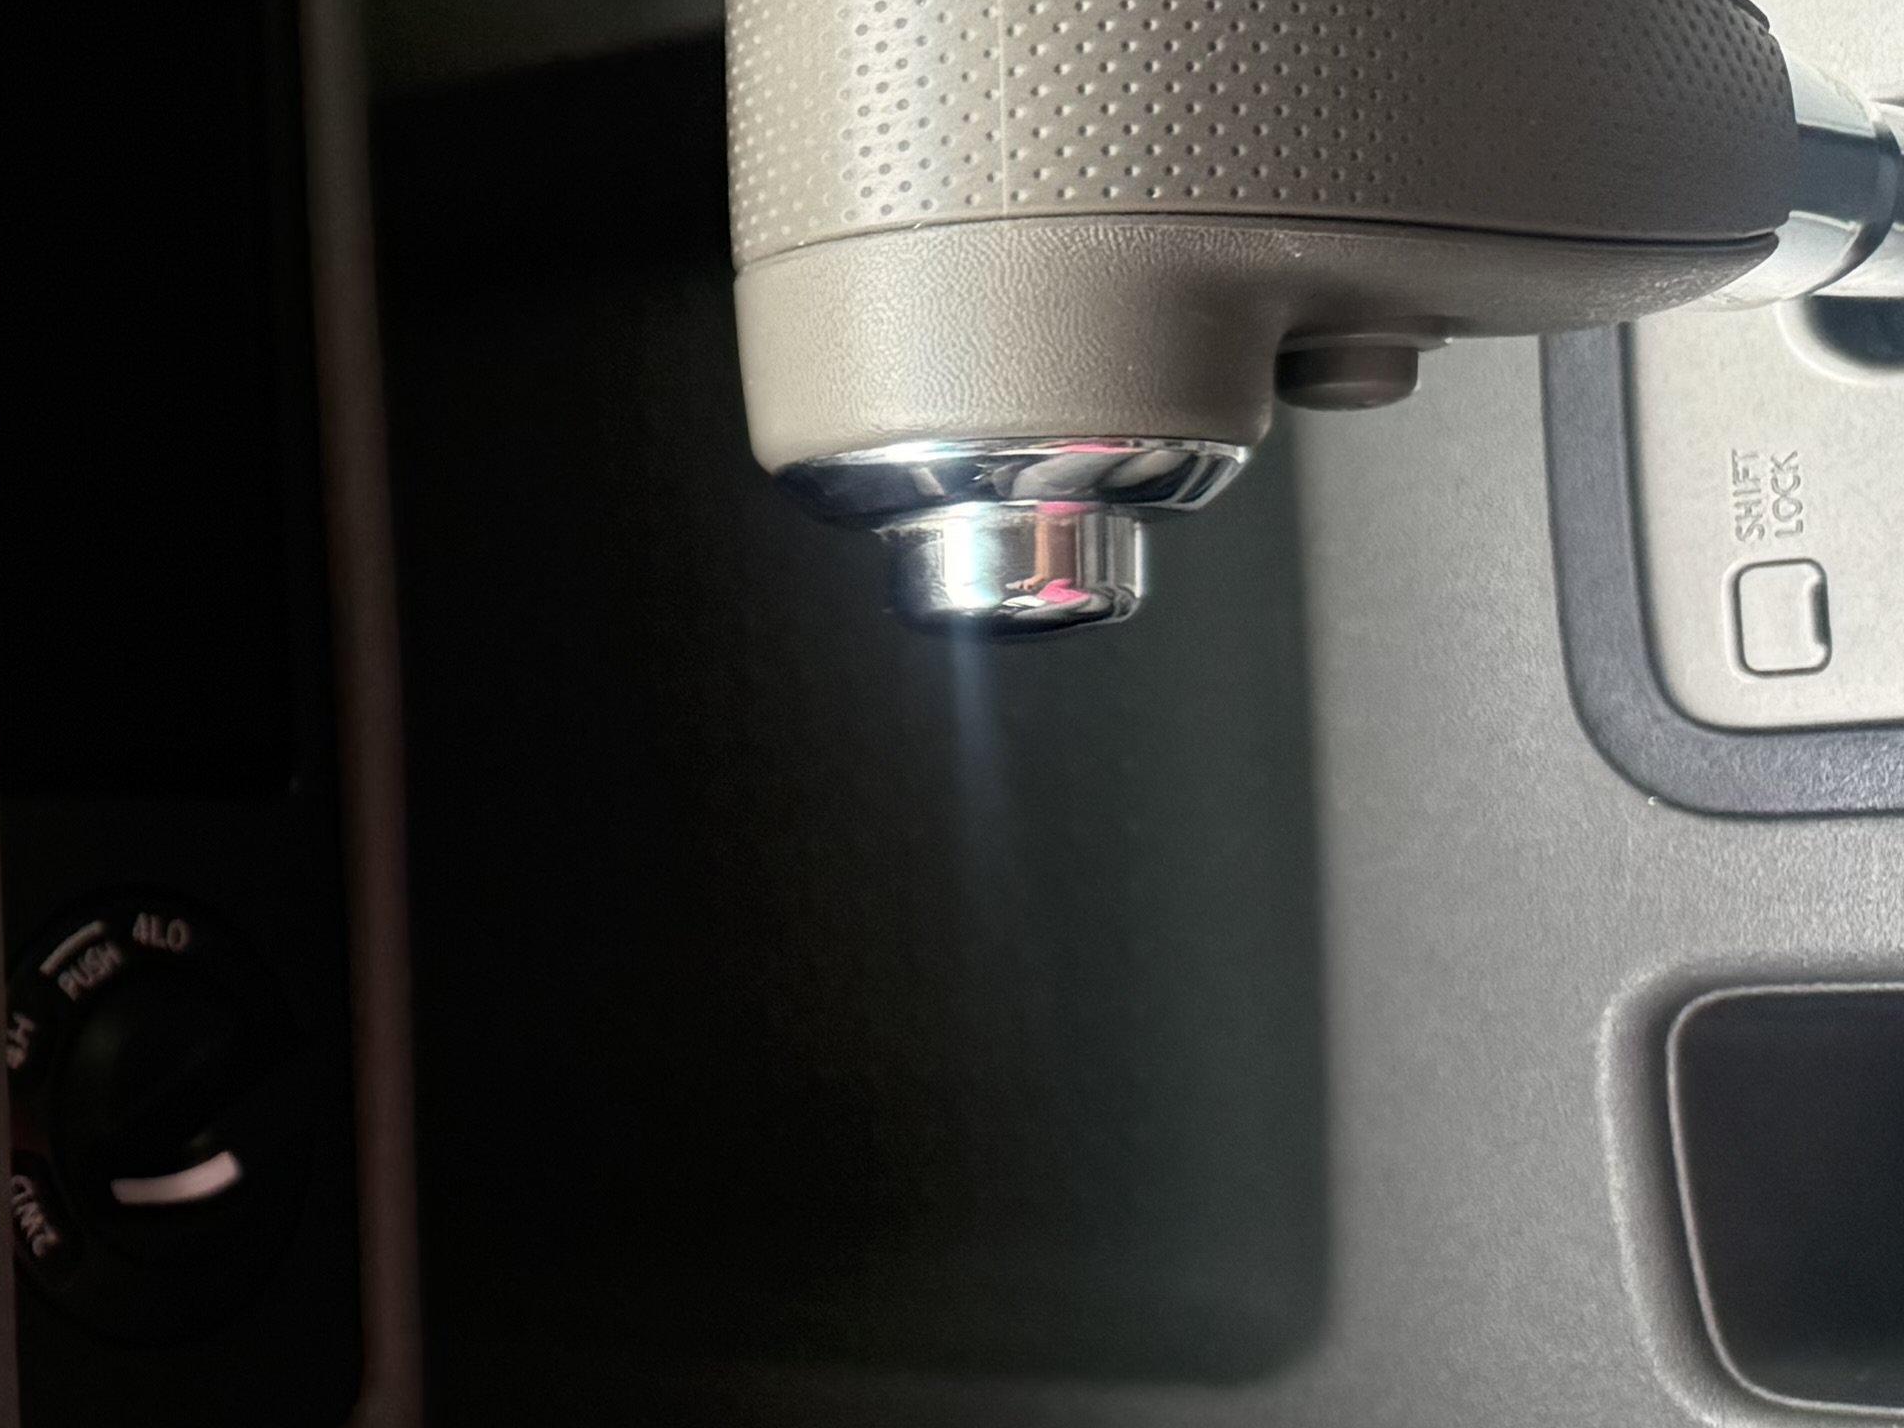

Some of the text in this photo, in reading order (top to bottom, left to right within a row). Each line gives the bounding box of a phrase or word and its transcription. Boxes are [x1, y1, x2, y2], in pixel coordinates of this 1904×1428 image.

[1731, 448, 1769, 544] SHIFT
[1770, 450, 1805, 539] LOCK
[8, 1176, 56, 1256] 2WD
